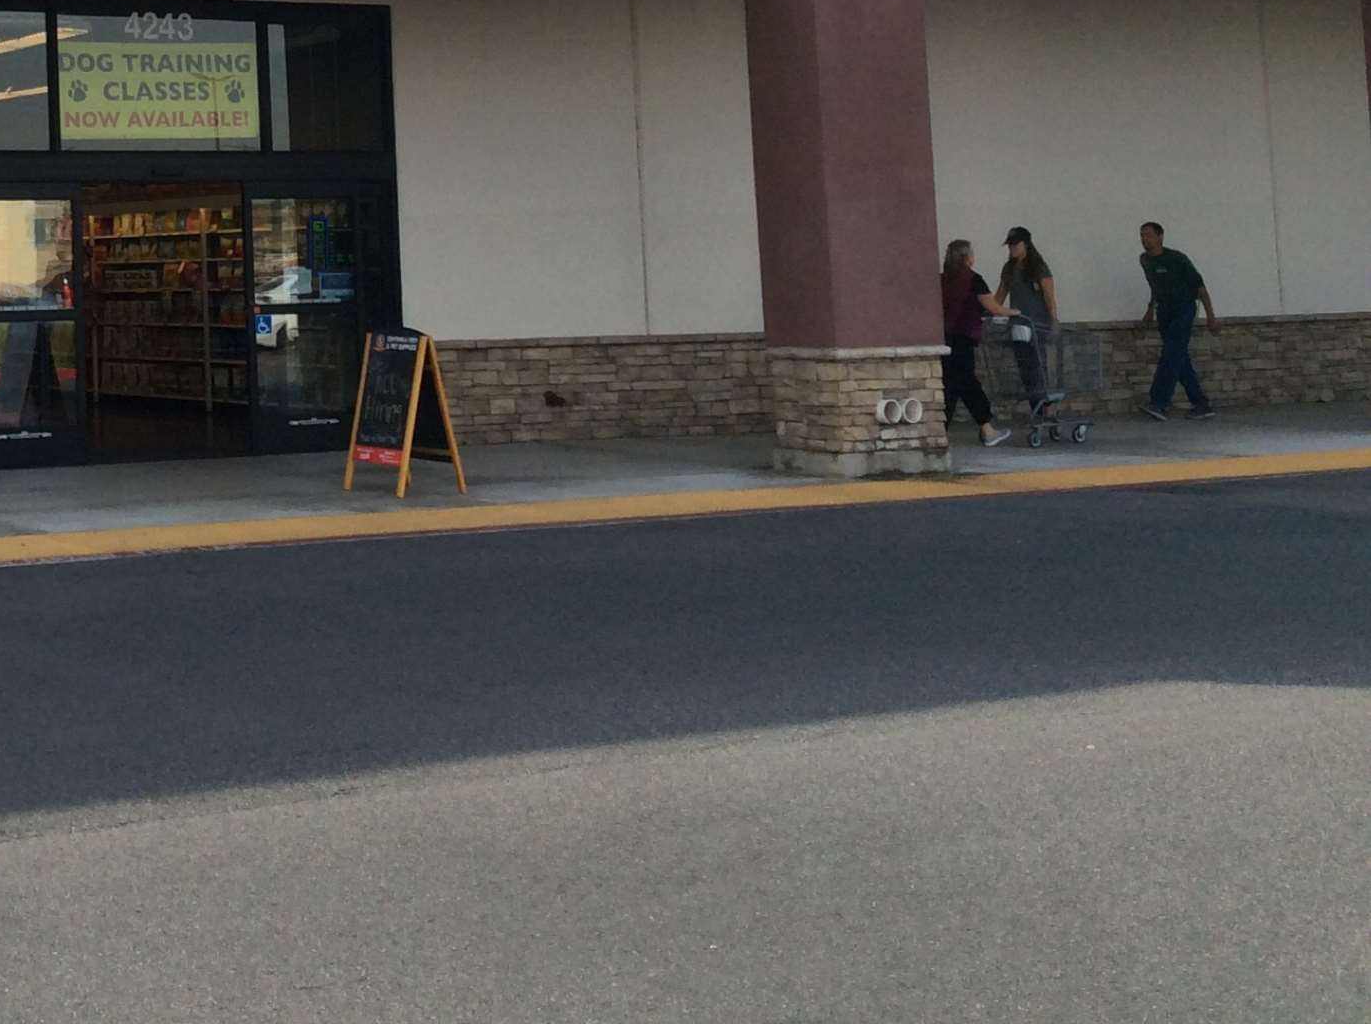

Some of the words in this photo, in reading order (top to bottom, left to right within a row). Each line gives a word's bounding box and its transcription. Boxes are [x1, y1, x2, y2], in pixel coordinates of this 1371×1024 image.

[124, 11, 194, 40] 4243
[59, 53, 114, 73] DOG
[121, 54, 251, 73] TRAINING
[103, 81, 210, 101] CLASSES
[64, 111, 120, 128] NOW
[127, 111, 250, 129] AVAILABLE!
